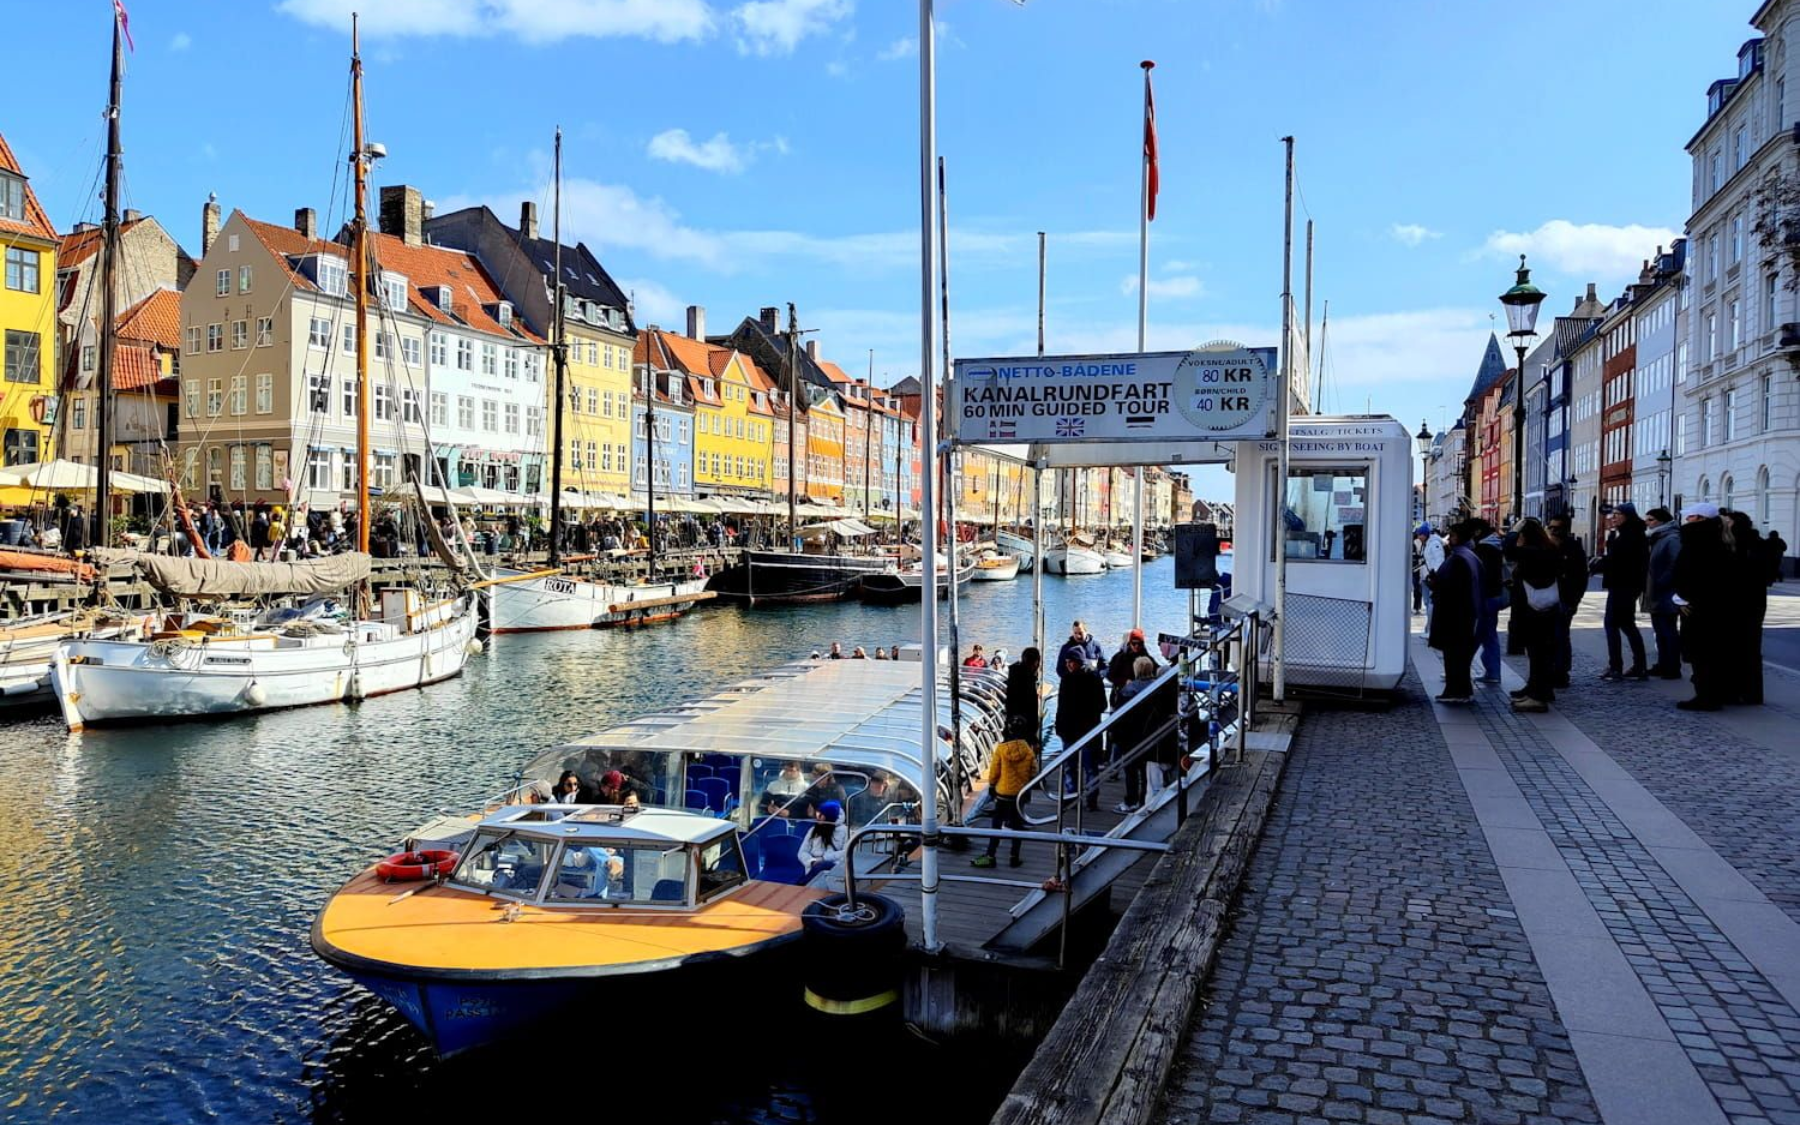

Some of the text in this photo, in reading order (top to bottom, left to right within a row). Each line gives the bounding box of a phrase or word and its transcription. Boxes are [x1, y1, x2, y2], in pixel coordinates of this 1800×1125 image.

[1188, 358, 1254, 366] VOKSNE/ADULT
[999, 362, 1136, 378] NETTO-BÅDENE
[1202, 368, 1252, 383] 80 KR
[964, 382, 1173, 403] KANALRUNDFART
[1194, 387, 1247, 395] BØRN/CHILD
[963, 400, 1170, 418] 60 MIN GUIDED TOUR
[1196, 397, 1249, 412] 40 KR
[1259, 442, 1386, 451] SIGTSEEING BY BOAT
[546, 579, 576, 594] ROTA
